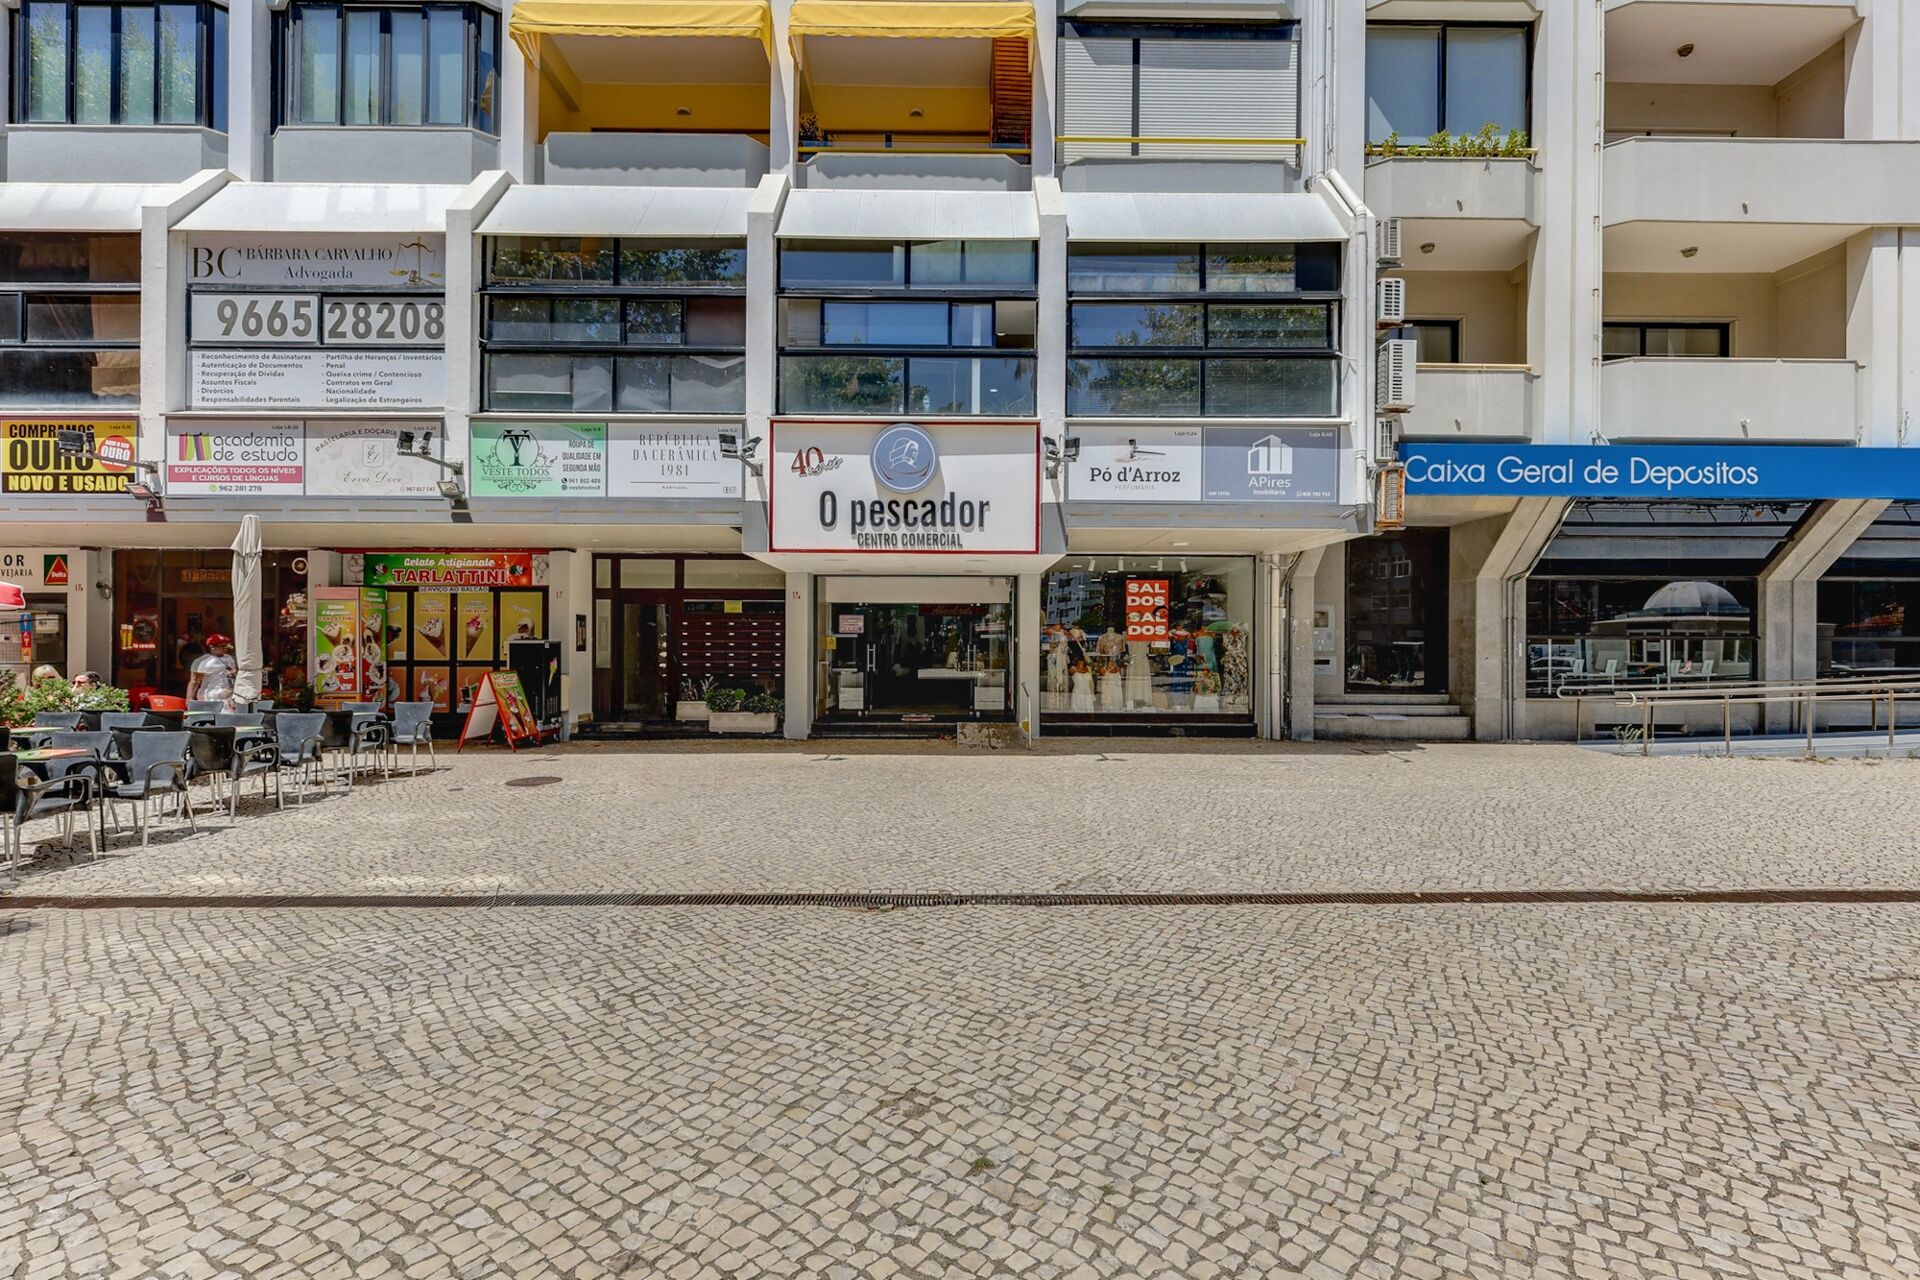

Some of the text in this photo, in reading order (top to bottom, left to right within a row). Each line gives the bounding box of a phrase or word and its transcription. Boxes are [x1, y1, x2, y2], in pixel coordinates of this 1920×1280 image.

[191, 245, 393, 279] BC BÁRBARA CARVALHO
[284, 265, 353, 279] Advogada
[217, 299, 445, 340] 9665 28208
[365, 354, 397, 362] Heranças
[201, 396, 267, 404] Responsabilidades
[213, 432, 295, 447] academia
[315, 430, 357, 452] PASTELARIA
[364, 428, 398, 436] DOÇARIA
[639, 431, 711, 446] REPÚBLICA
[100, 445, 131, 461] OURO
[213, 446, 298, 461] de estudo
[562, 452, 601, 460] QUALIDADE EM
[633, 447, 717, 461] DA CERÂMICA
[562, 463, 601, 472] SEGUNDA MÃO
[790, 446, 825, 475] 40
[174, 466, 228, 474] EXPLICAÇÕES
[271, 466, 296, 474] NÍVEIS
[482, 468, 550, 476] VESTE TODOS
[661, 464, 689, 476] 1981
[1089, 467, 1181, 483] Pó d'Arroz
[1404, 455, 1486, 484] Caixa
[1497, 455, 1573, 485] Geral
[1584, 459, 1619, 485] de
[8, 475, 129, 492] NOVO E USADO
[1248, 476, 1292, 488] APires
[819, 490, 991, 535] O pescador
[857, 533, 963, 548] CENTRO COMERCIAL
[404, 557, 496, 569] Gelato Artigianale
[393, 568, 508, 584] TARLATTINI
[1127, 583, 1166, 593] SAL
[1127, 596, 1166, 606] DOS
[1128, 612, 1167, 622] SAL
[1127, 625, 1167, 635] DOS
